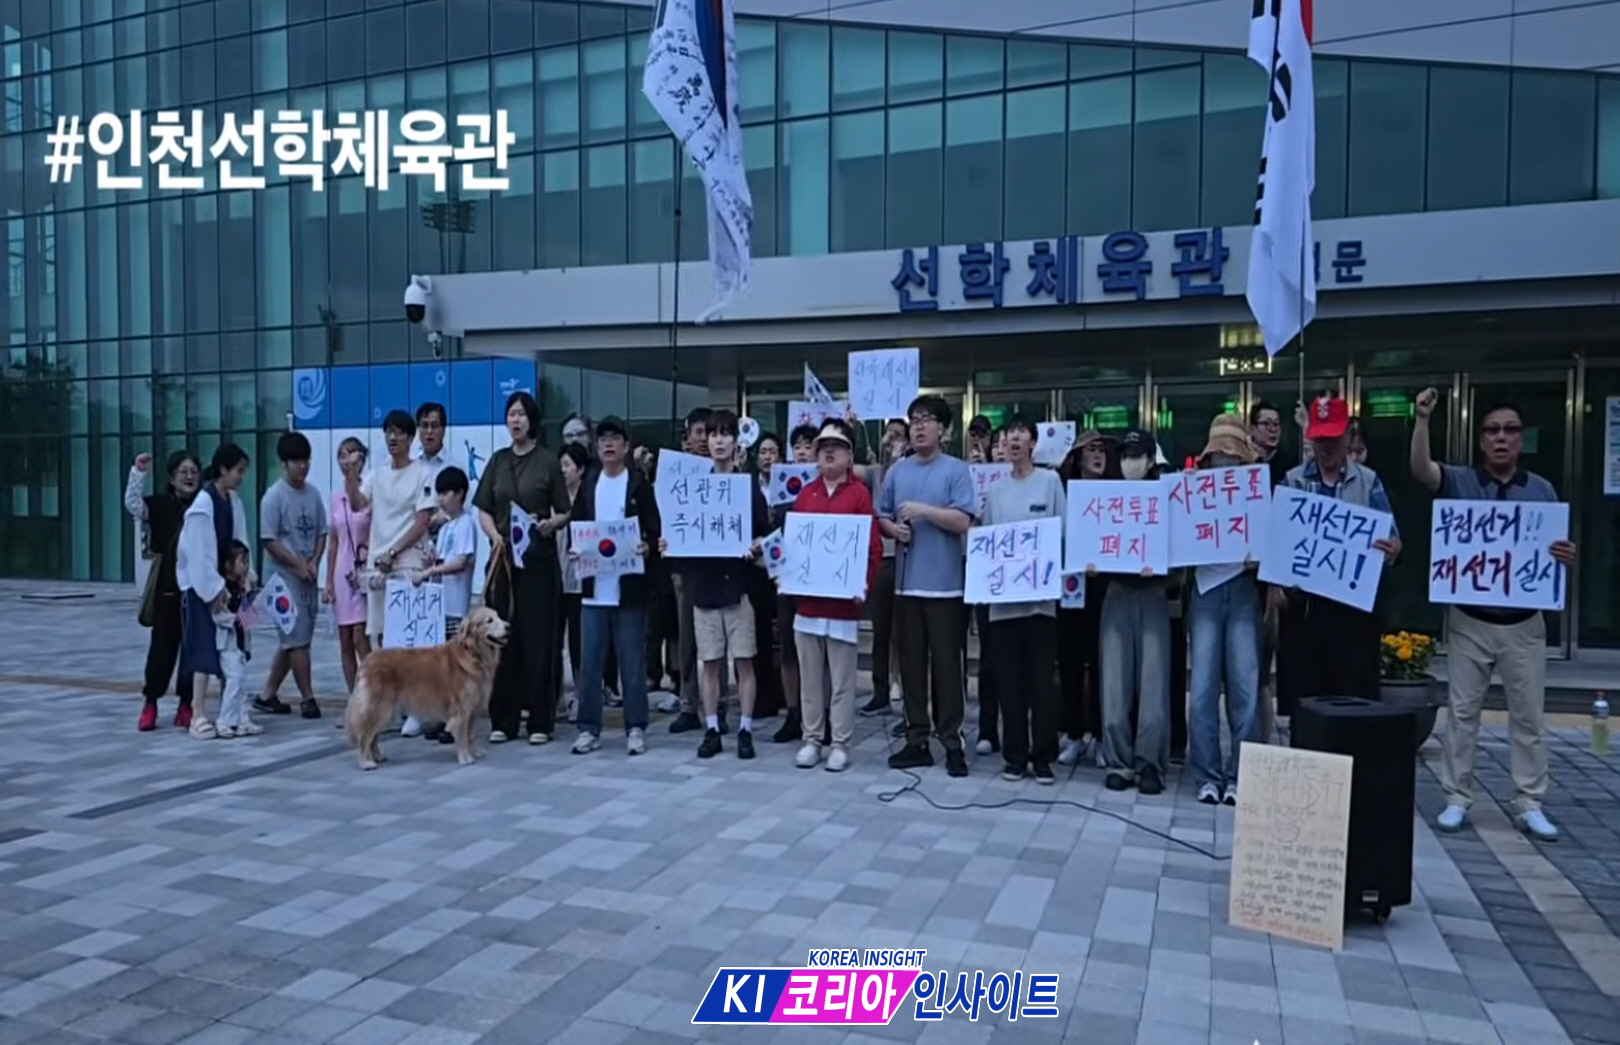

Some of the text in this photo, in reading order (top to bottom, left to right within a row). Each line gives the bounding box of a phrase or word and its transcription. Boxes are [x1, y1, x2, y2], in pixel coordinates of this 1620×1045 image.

[891, 227, 1367, 312] 선학체육관 문
[670, 477, 731, 505] 선관위
[1168, 467, 1263, 515] 사전투표
[1082, 495, 1159, 525] 사전투표
[1289, 496, 1377, 550] 재선거
[794, 521, 861, 561] 재선거
[970, 525, 1039, 560] 재선거
[388, 586, 442, 621] 재선거
